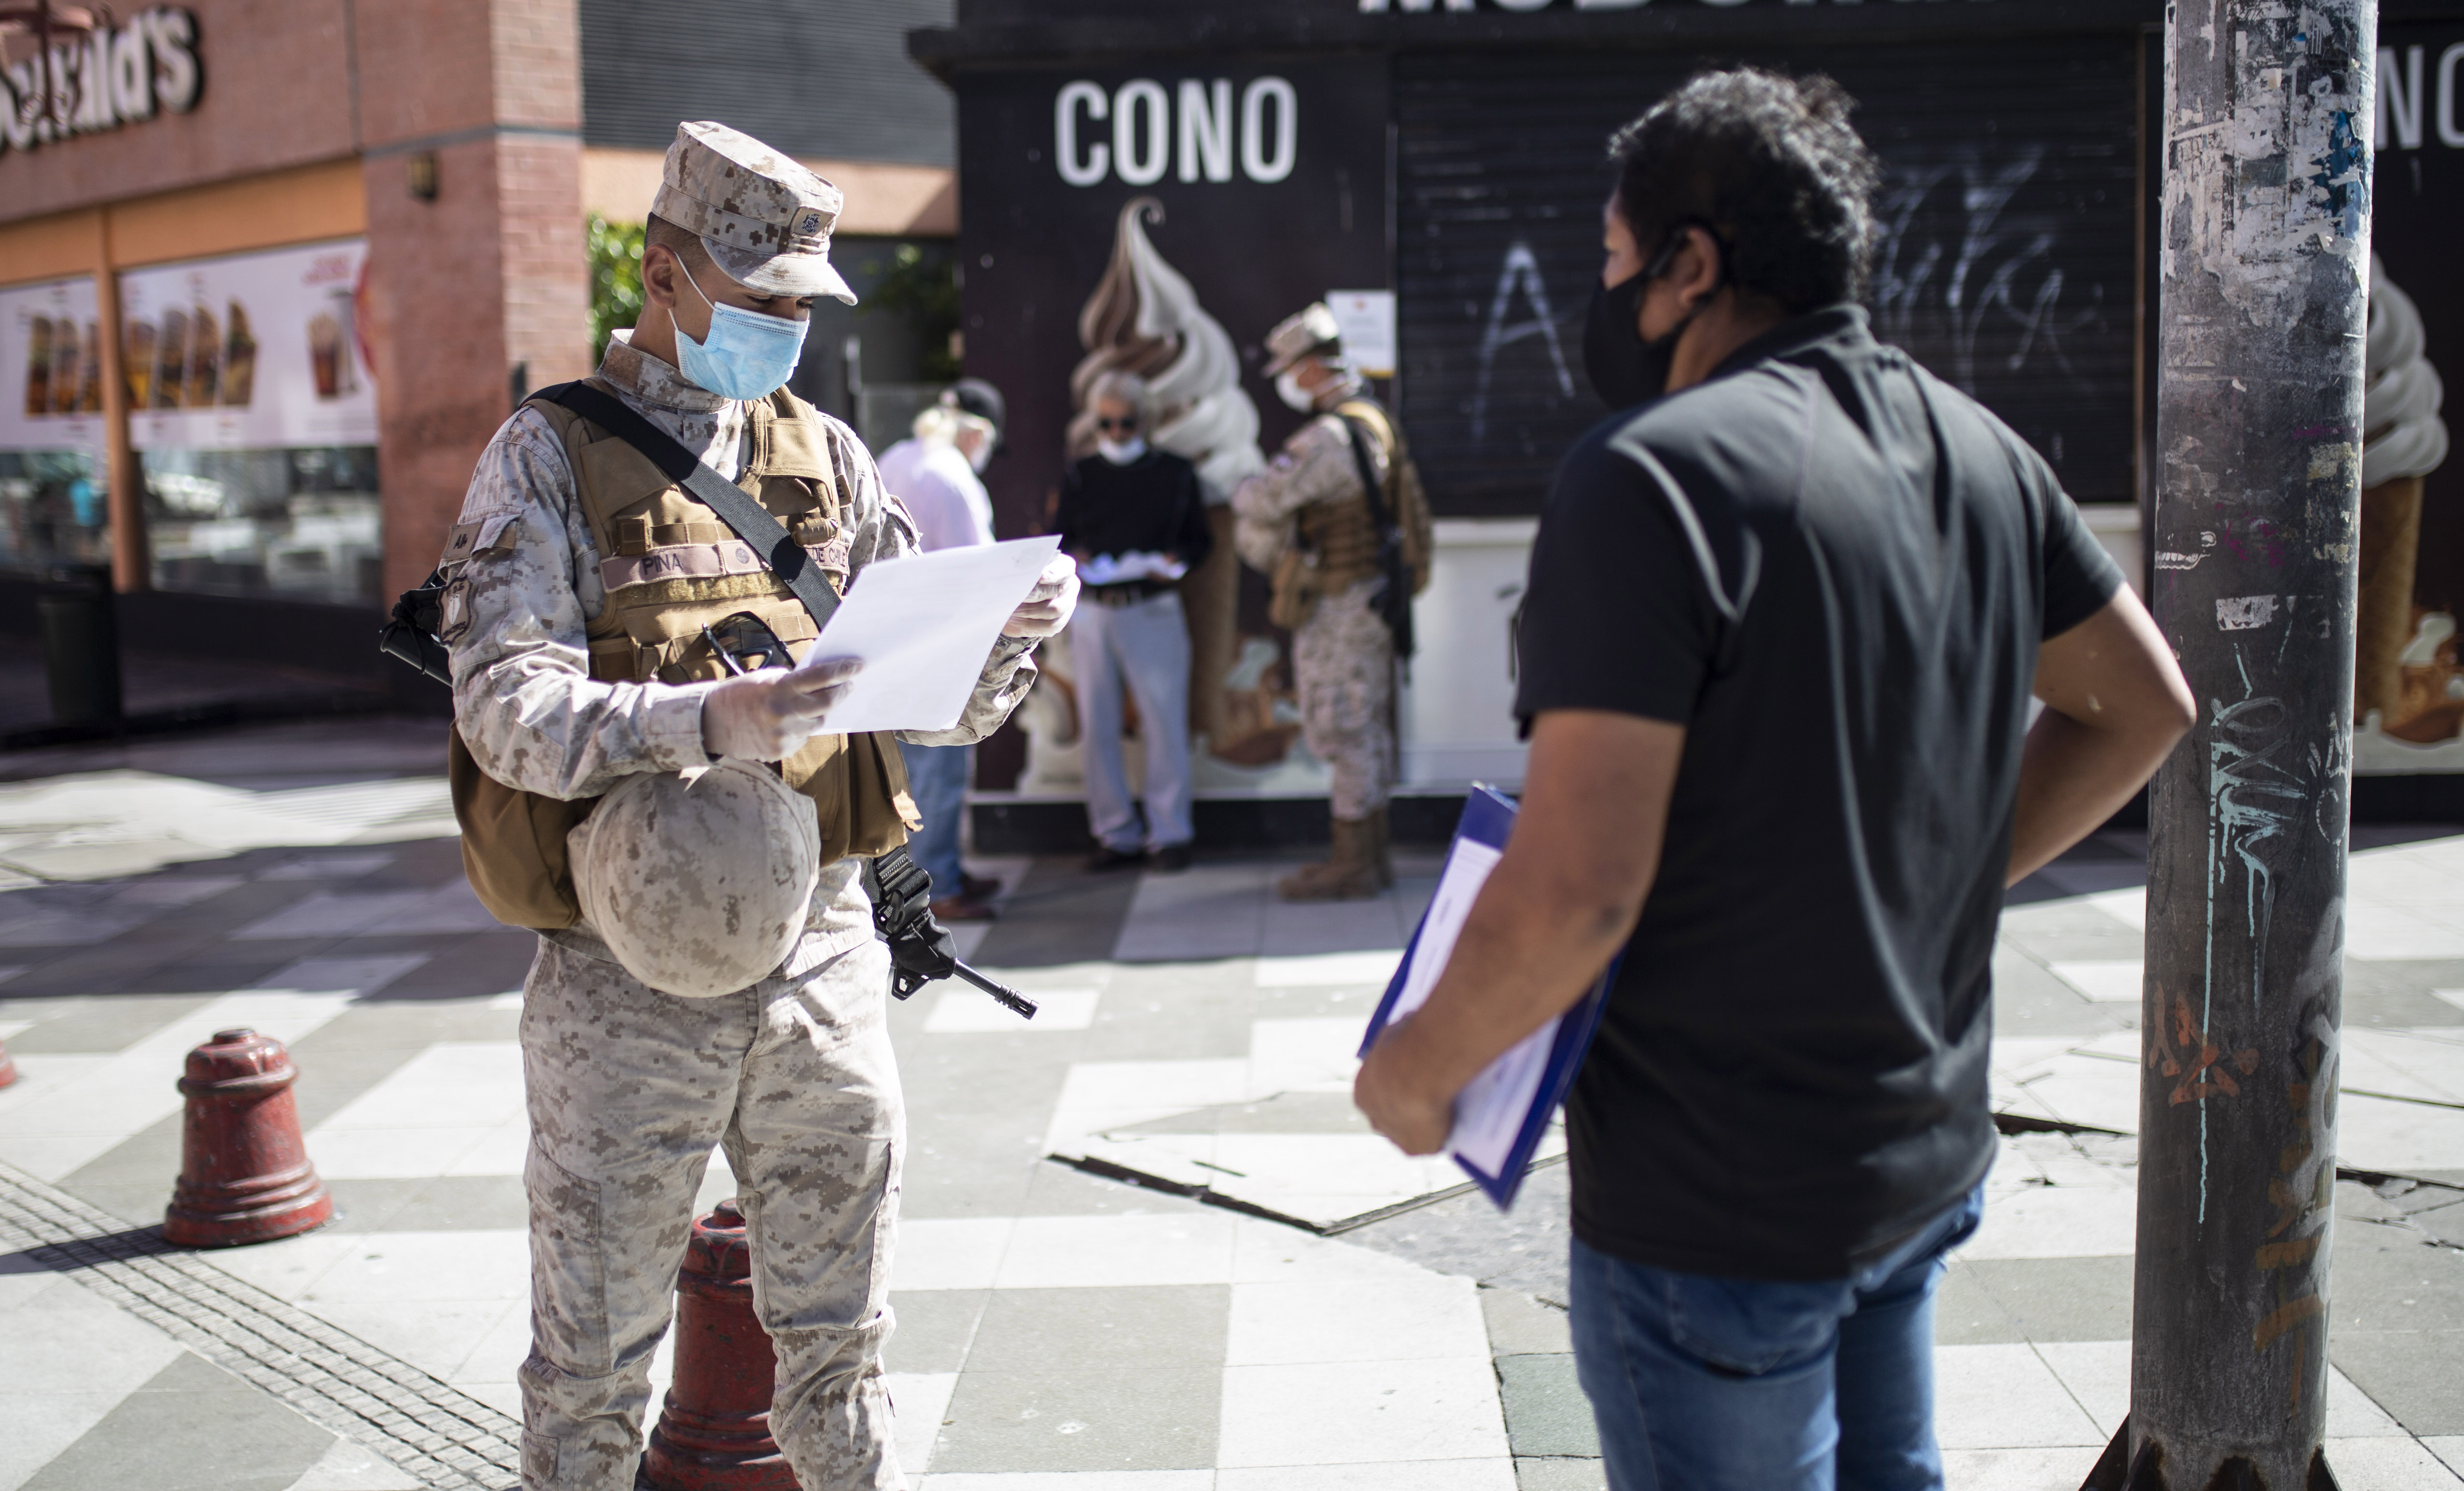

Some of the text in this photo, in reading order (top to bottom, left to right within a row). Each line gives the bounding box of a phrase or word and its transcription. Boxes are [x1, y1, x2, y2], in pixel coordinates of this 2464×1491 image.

[1055, 77, 1297, 186] CONO
[641, 549, 684, 576] PIÑA
[812, 547, 846, 567] DE CHILE
